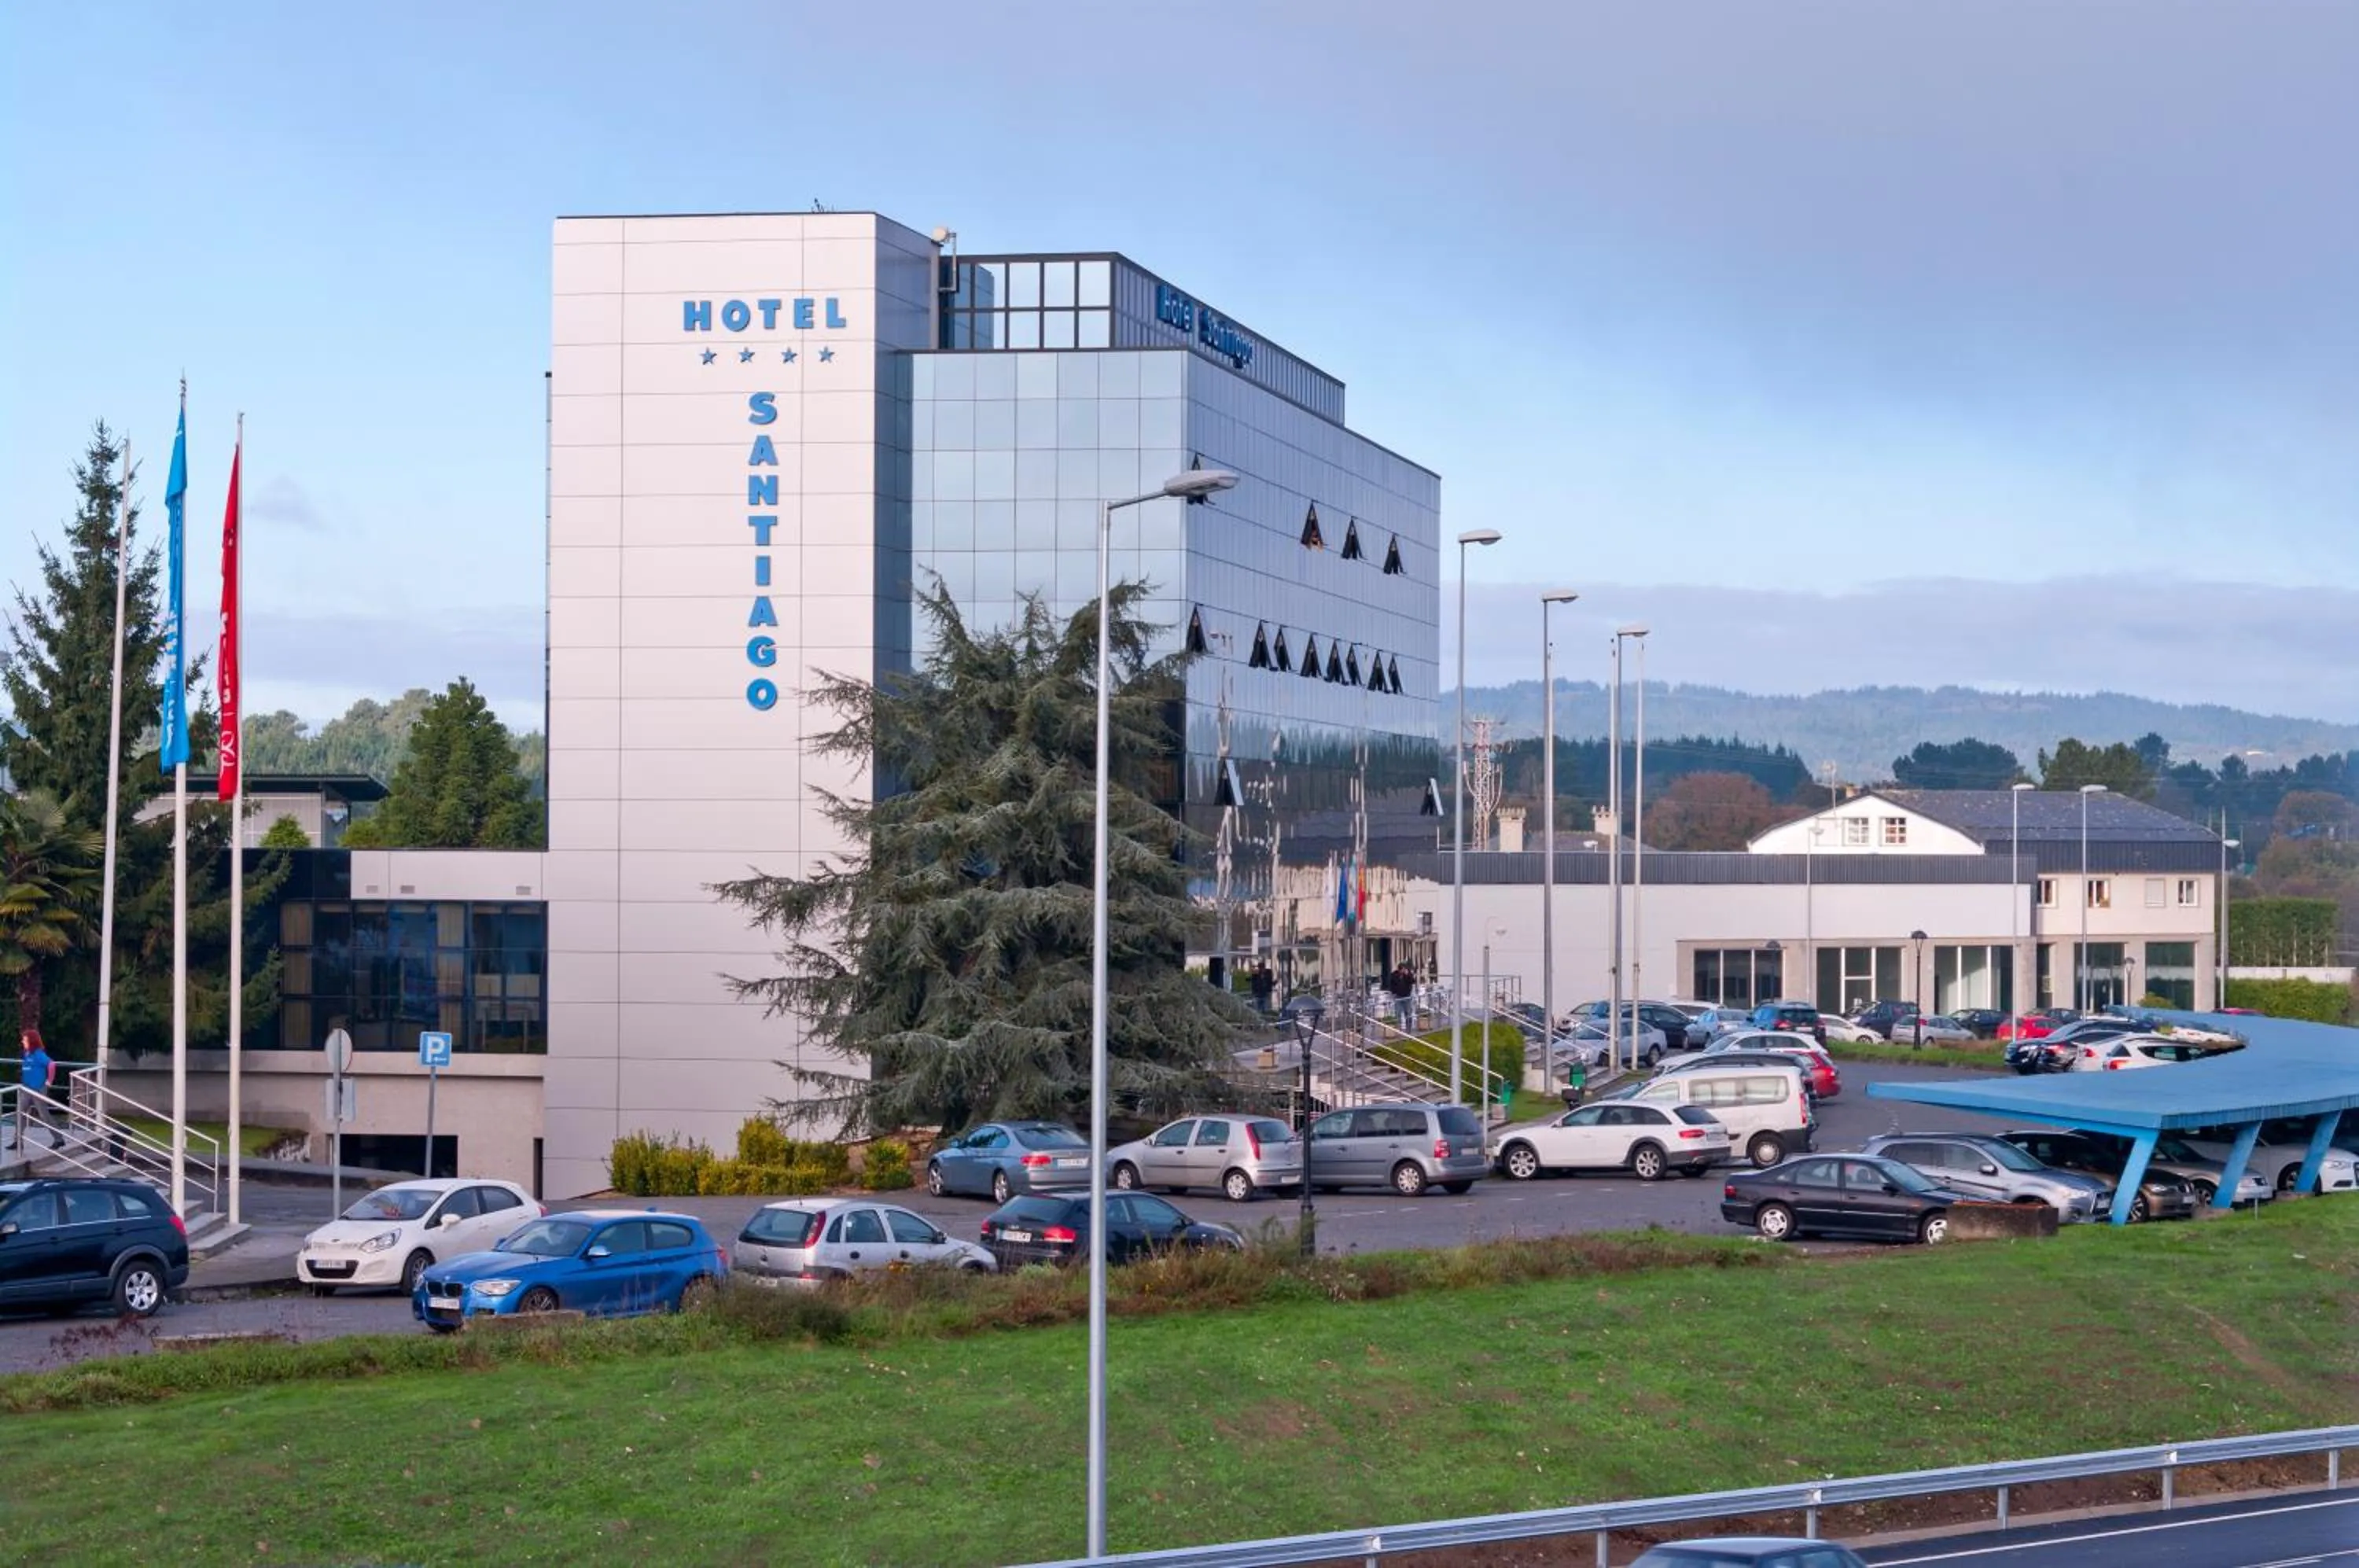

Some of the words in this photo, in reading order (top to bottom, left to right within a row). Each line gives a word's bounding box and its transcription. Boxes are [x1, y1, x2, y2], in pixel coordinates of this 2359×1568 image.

[683, 297, 847, 331] HOTEL
[747, 392, 778, 711] SANTIAGO
[427, 1036, 445, 1062] P
